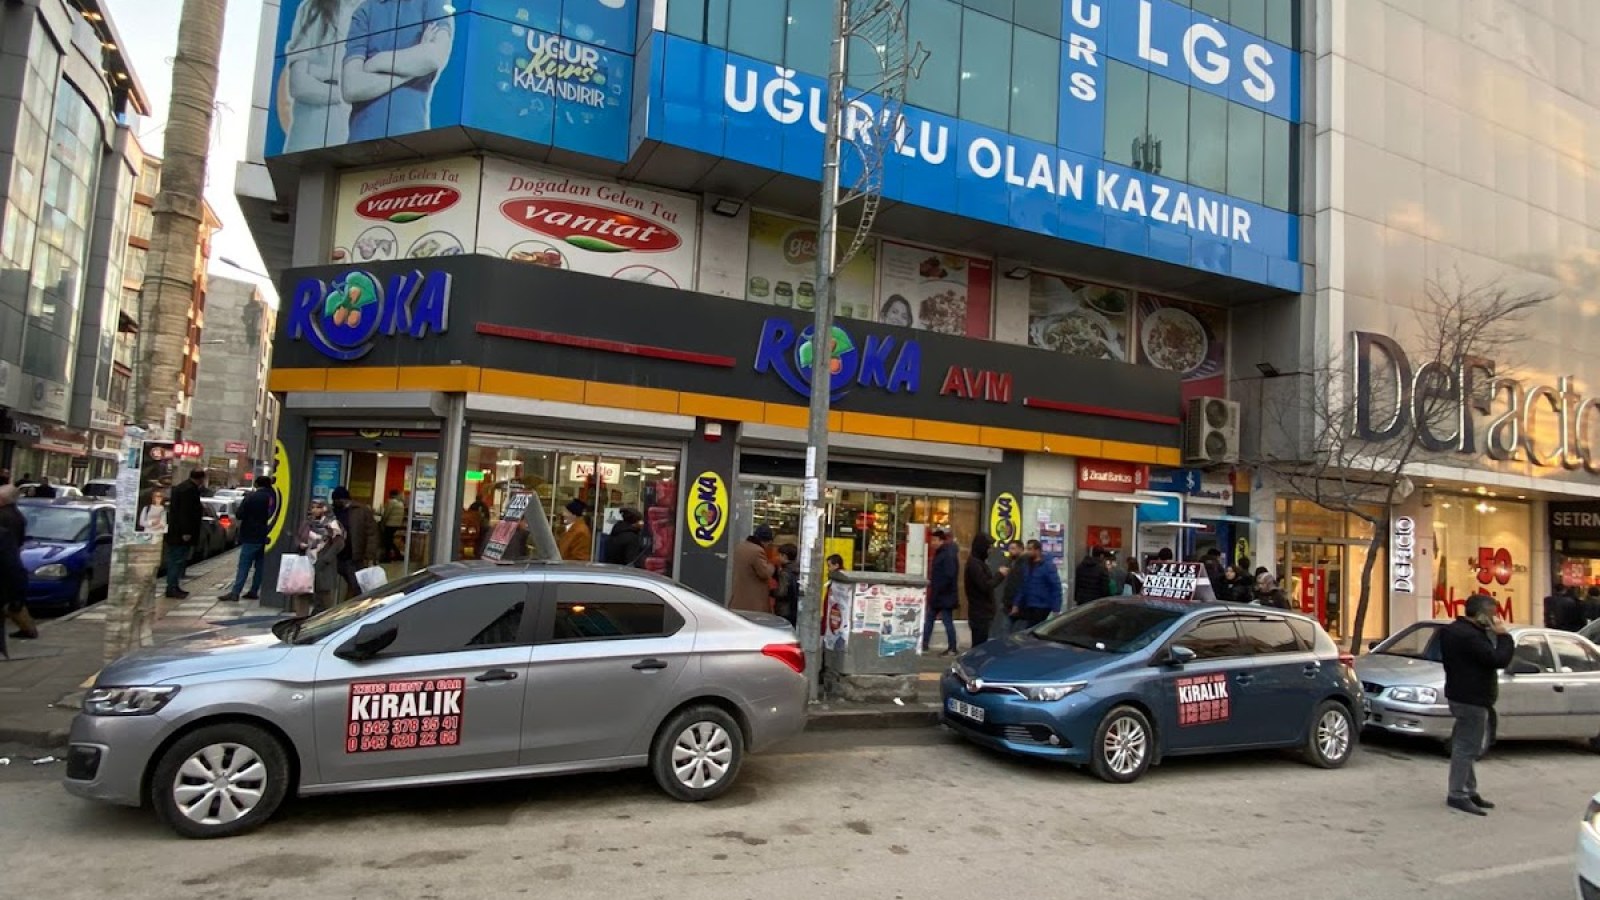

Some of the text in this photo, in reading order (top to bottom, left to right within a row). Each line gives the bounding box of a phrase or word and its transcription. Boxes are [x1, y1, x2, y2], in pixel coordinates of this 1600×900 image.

[1138, 0, 1276, 103] LGS
[514, 67, 604, 109] KAZANDIRIR
[409, 168, 437, 182] Gelen
[441, 168, 460, 183] Tat
[968, 137, 1084, 201] OLAN
[1097, 169, 1252, 244] KAZANIR
[366, 190, 448, 213] vantat
[507, 176, 678, 225] Doğadan Gelen Tat
[524, 205, 662, 243] vantat
[287, 268, 452, 361] ROKA
[753, 317, 1013, 404] ROKA AVM
[695, 476, 721, 542] ROKA
[1160, 563, 1197, 574] ZEUS
[347, 736, 358, 752] 0
[349, 722, 360, 737] 0
[362, 720, 389, 736] 542
[442, 715, 459, 730] 41
